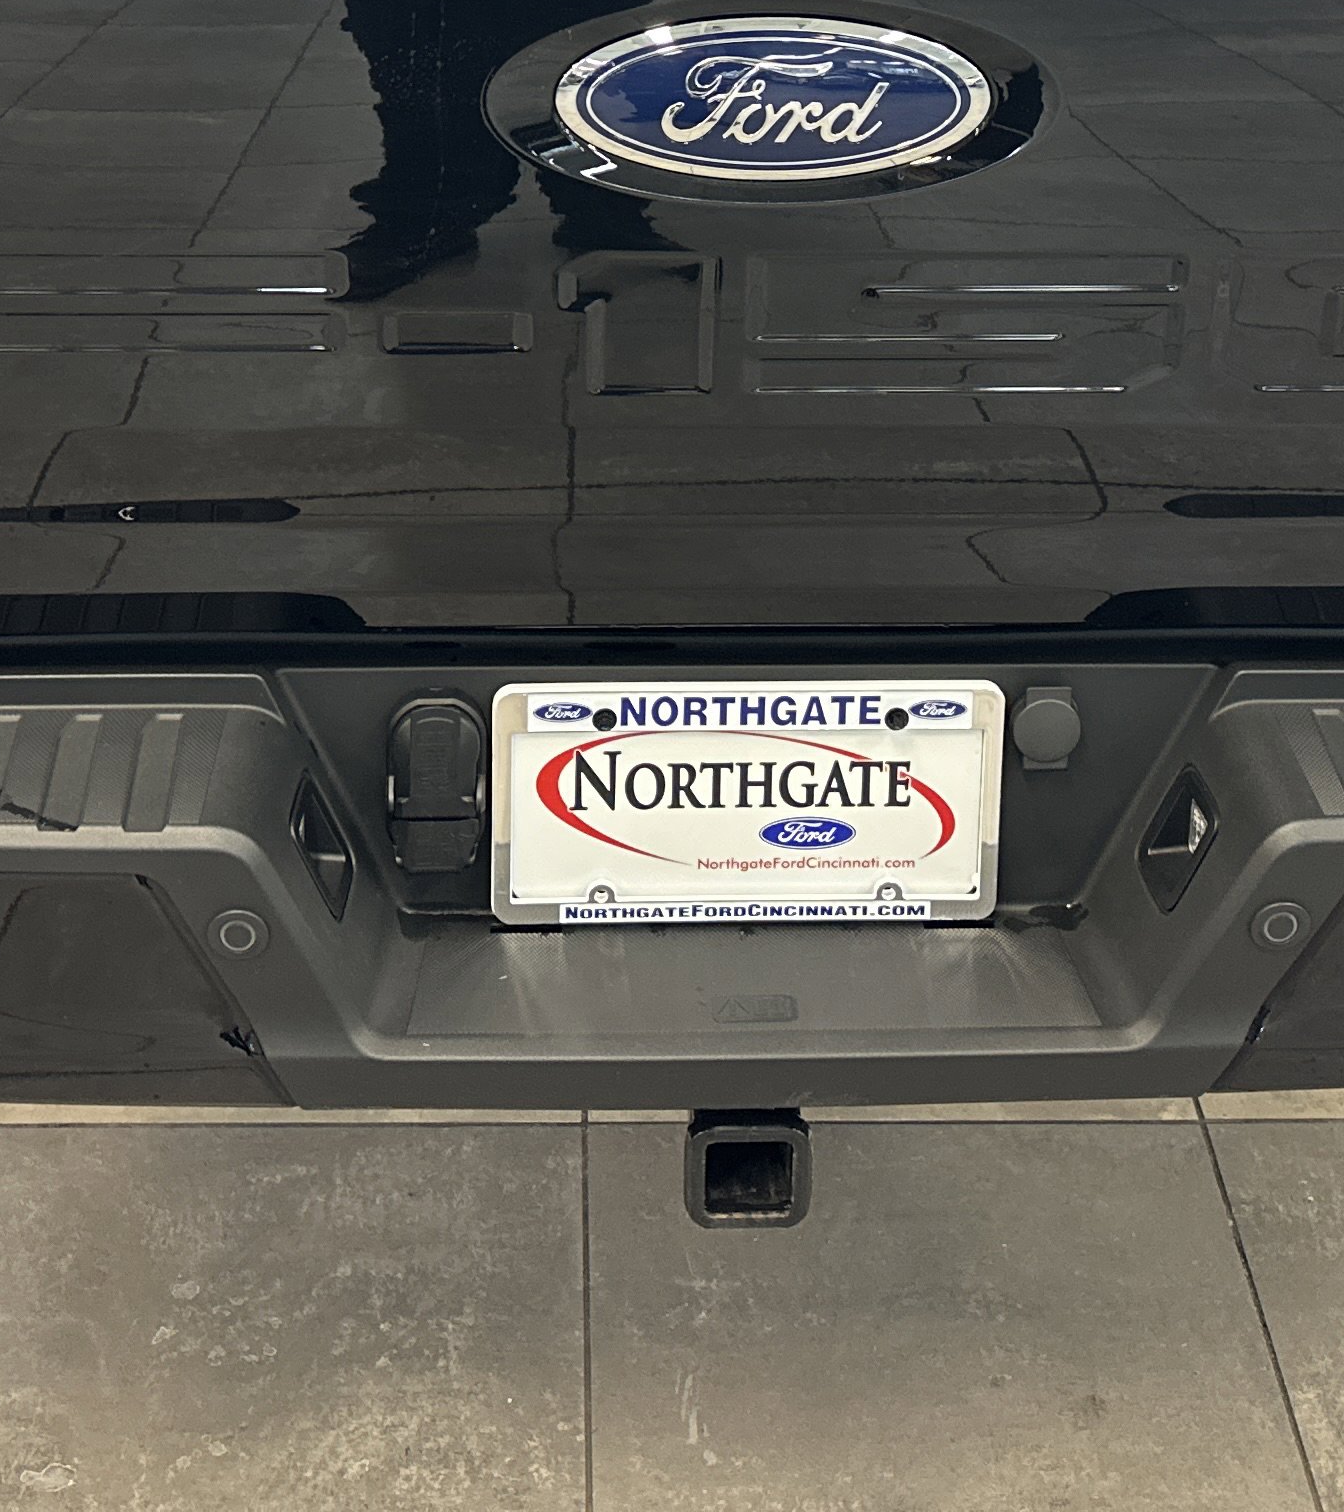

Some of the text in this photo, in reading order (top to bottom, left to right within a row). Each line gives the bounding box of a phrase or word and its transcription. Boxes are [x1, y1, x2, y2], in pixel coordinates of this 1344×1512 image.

[661, 55, 889, 144] Ford
[620, 695, 882, 727] NORTHGATE
[569, 750, 912, 811] NORTHGATE
[777, 821, 836, 844] Ford
[697, 855, 916, 873] NorthgateFordCincinnati.com
